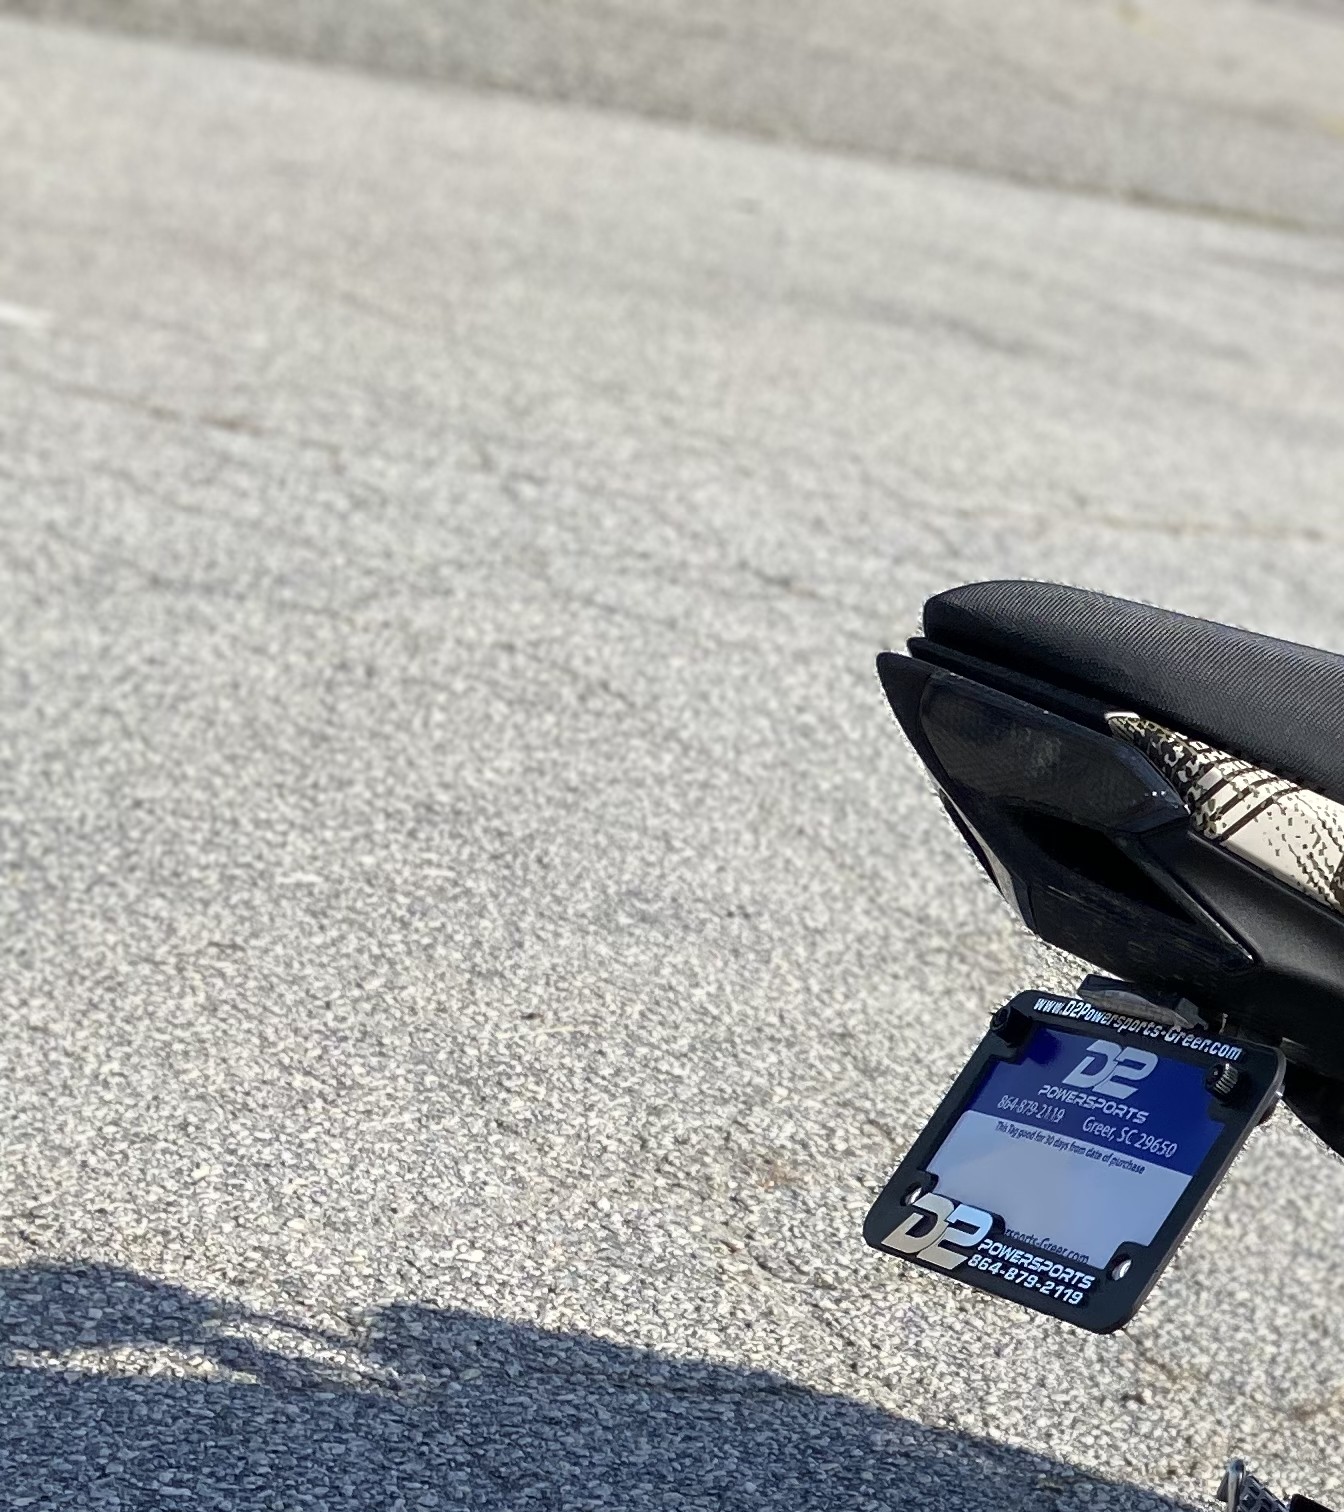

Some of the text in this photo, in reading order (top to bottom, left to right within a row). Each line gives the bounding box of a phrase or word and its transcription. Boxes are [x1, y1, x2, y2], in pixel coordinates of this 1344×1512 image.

[1033, 998, 1243, 1061] www.D2Powersports-Greer.com
[1062, 1039, 1158, 1100] D2
[997, 1095, 1178, 1159] 864-879-2119 Greer, SC 29650
[1037, 1084, 1150, 1125] POWERSPORTS
[880, 1192, 994, 1270] D2
[967, 1253, 1084, 1306] 864-879-2119
[977, 1238, 1096, 1290] POWERSPORTS
